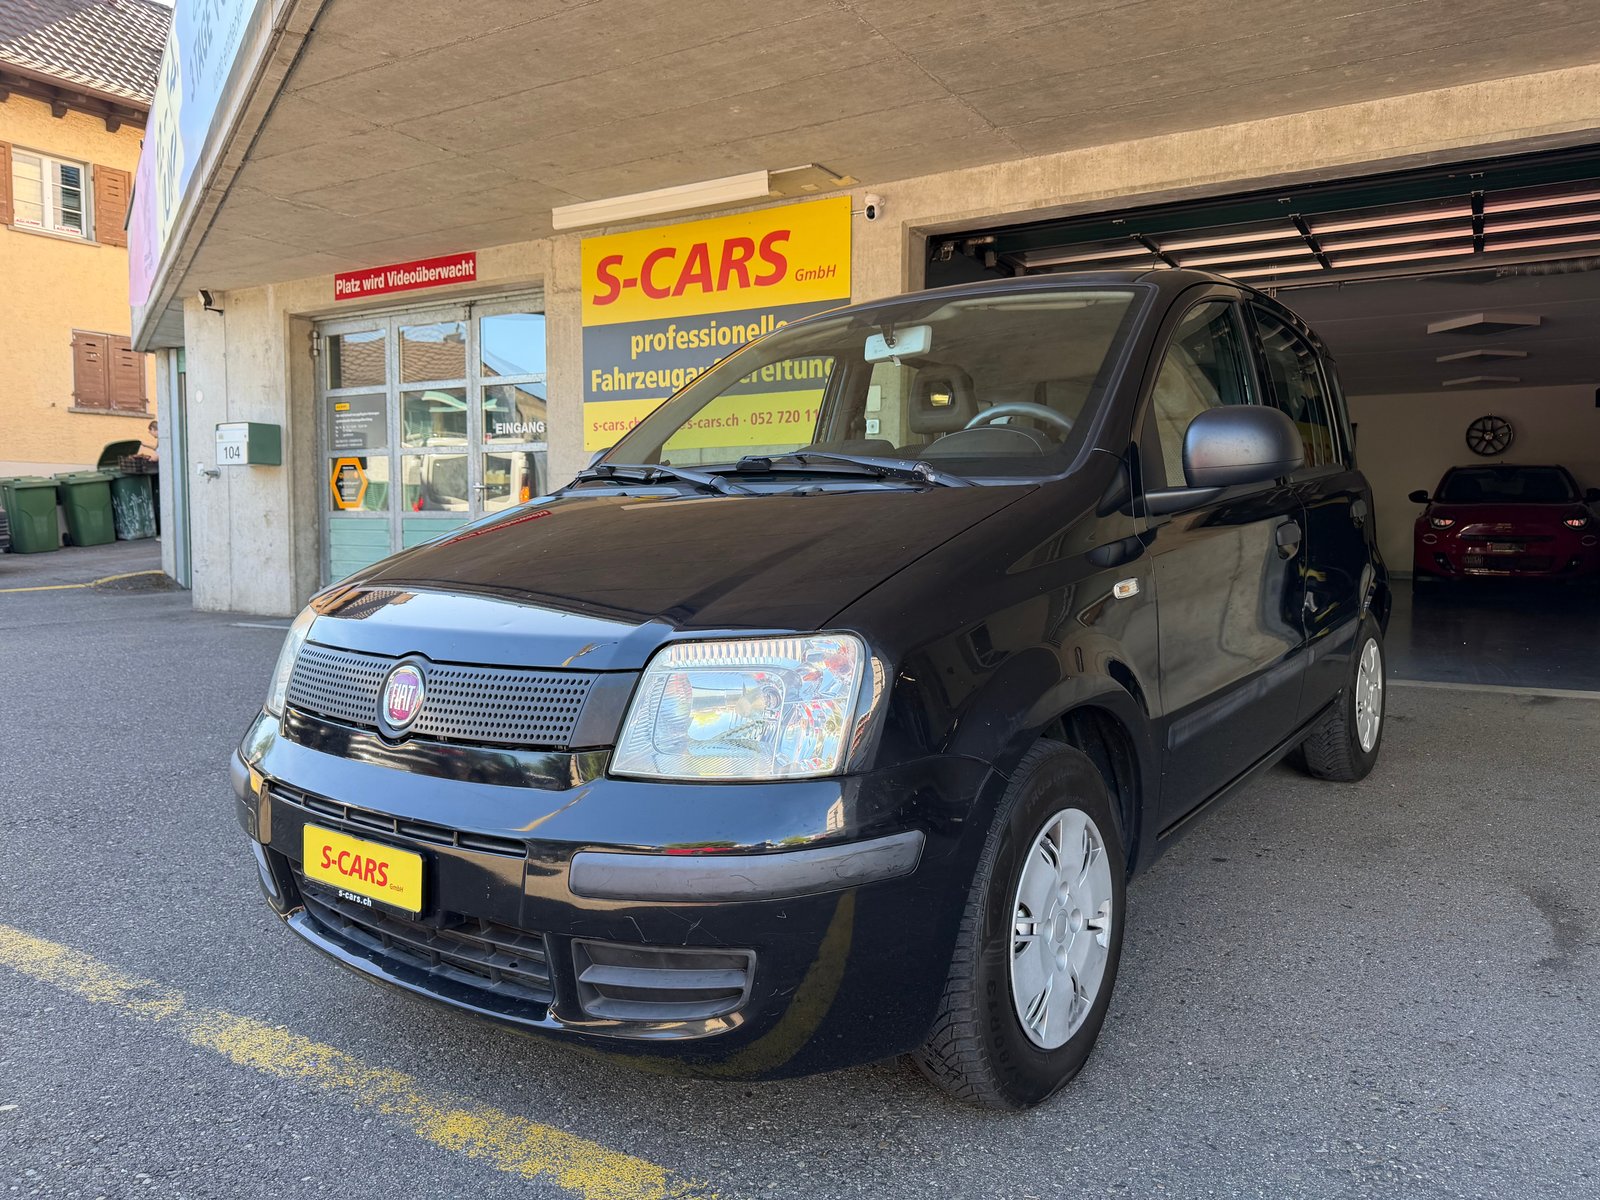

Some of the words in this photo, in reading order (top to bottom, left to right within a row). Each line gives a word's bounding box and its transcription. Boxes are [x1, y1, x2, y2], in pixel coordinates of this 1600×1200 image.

[336, 279, 361, 295] Platz
[363, 273, 385, 291] wird
[387, 259, 475, 287] Videoüberwacht
[592, 230, 791, 306] S-CARS
[795, 264, 837, 282] GmbH
[495, 421, 545, 435] EINGANG
[681, 413, 739, 430] s-cars.ch
[751, 412, 773, 426] 052
[777, 410, 801, 424] 720
[224, 446, 241, 459] 104
[389, 683, 417, 711] FIAT
[321, 845, 389, 887] S-CARS
[389, 883, 404, 893] GmbH
[338, 889, 372, 907] s-cars.ch
